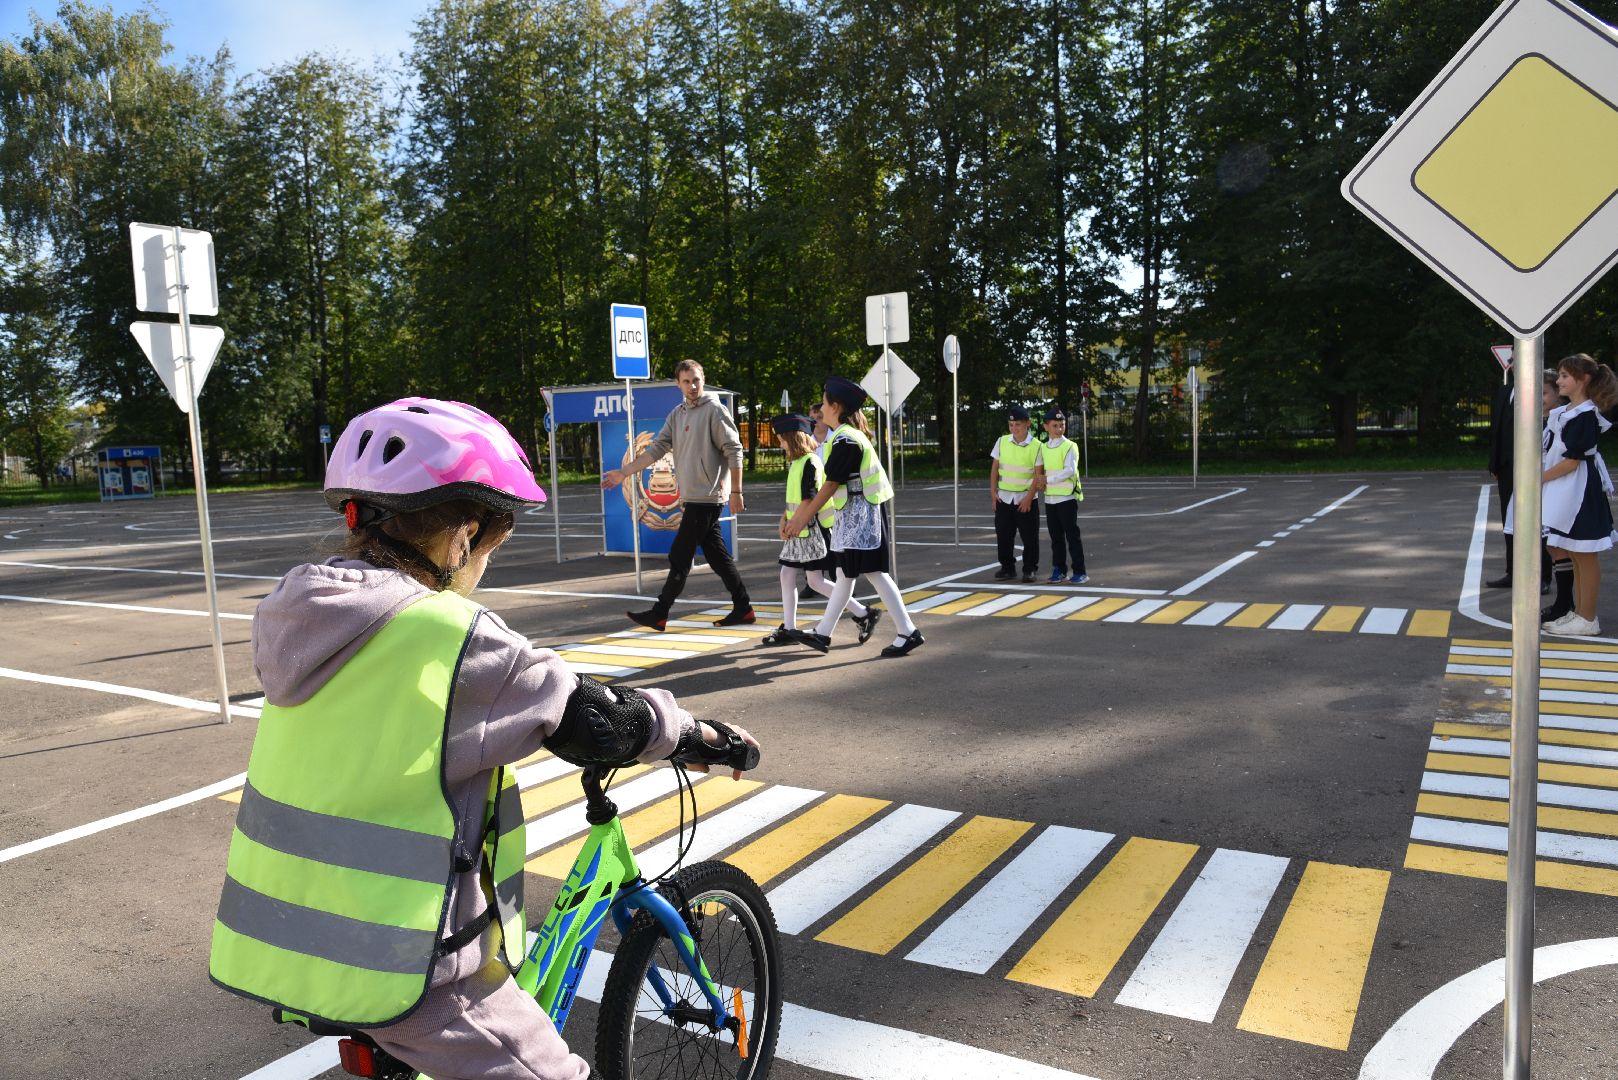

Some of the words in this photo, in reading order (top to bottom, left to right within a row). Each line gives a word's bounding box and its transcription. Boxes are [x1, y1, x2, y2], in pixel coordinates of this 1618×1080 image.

[619, 330, 642, 345] ДПС
[593, 394, 635, 418] ДПС
[528, 859, 582, 965] PILOT
